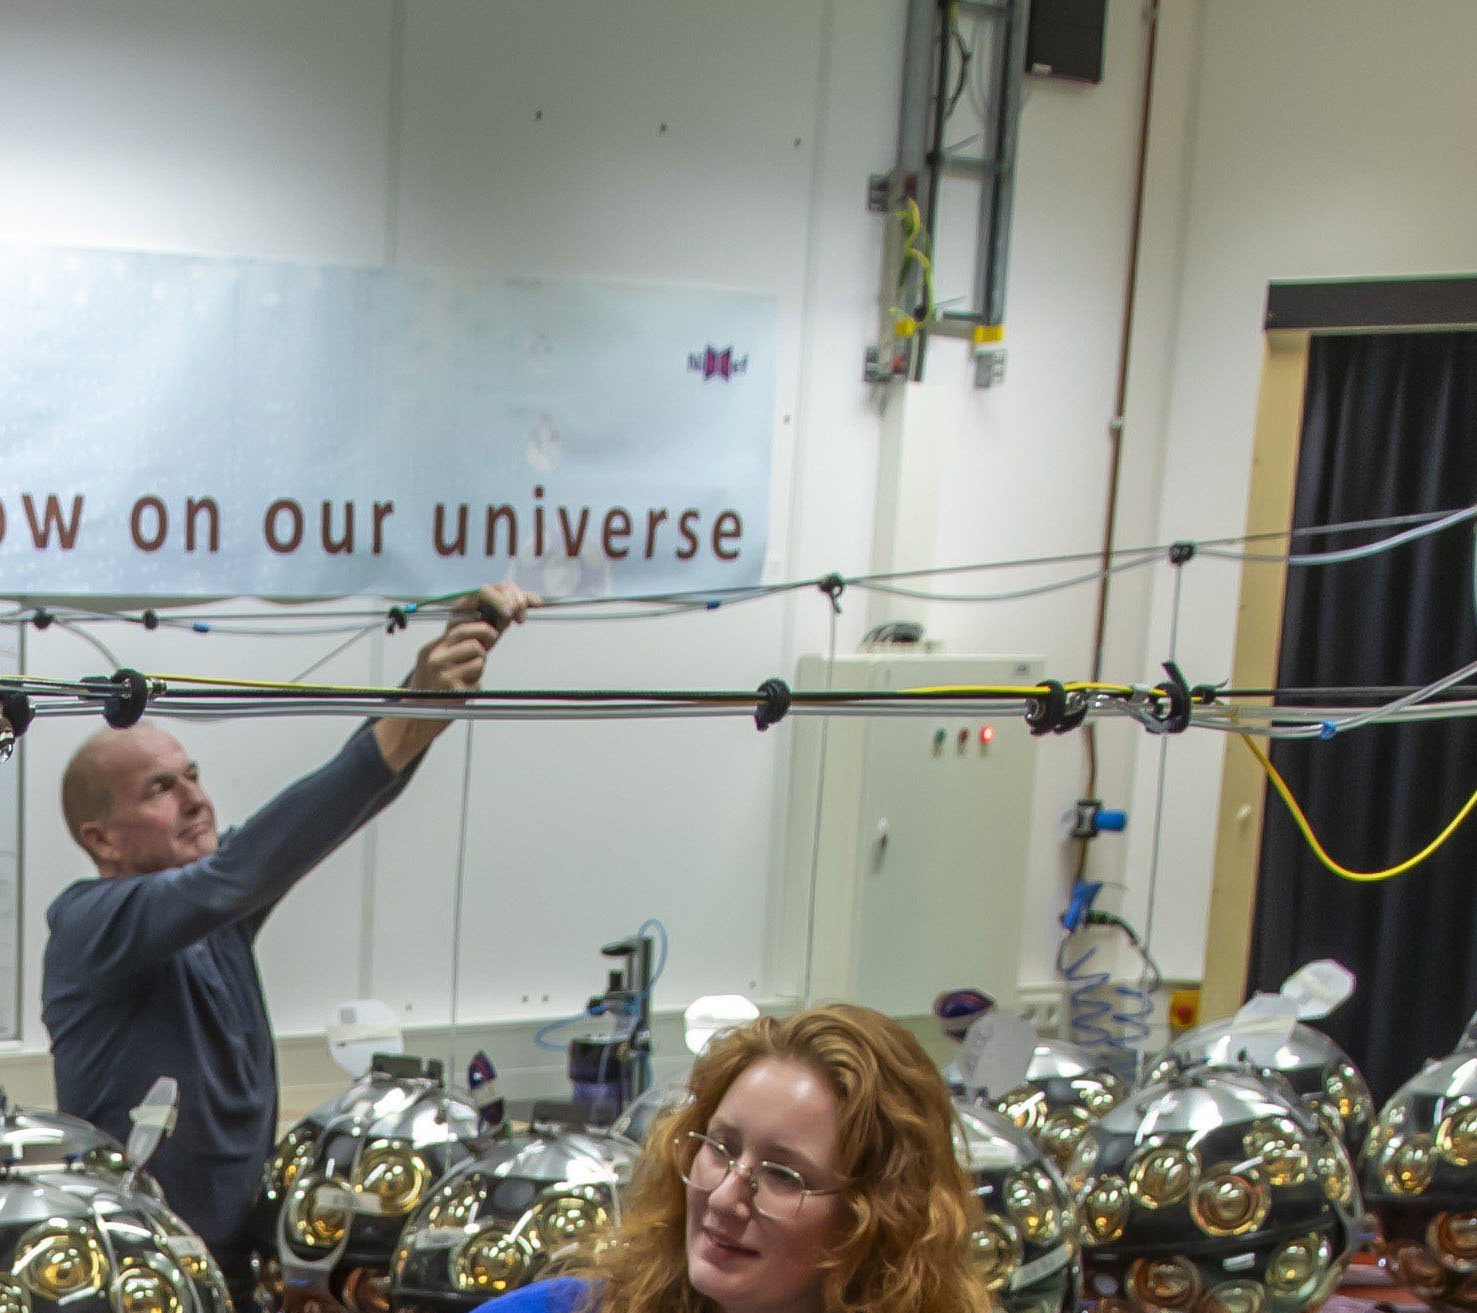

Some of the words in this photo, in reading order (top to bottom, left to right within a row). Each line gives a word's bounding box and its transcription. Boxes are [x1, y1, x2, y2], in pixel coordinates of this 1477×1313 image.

[131, 493, 219, 552] on
[264, 497, 394, 555] our
[433, 485, 742, 560] universe
